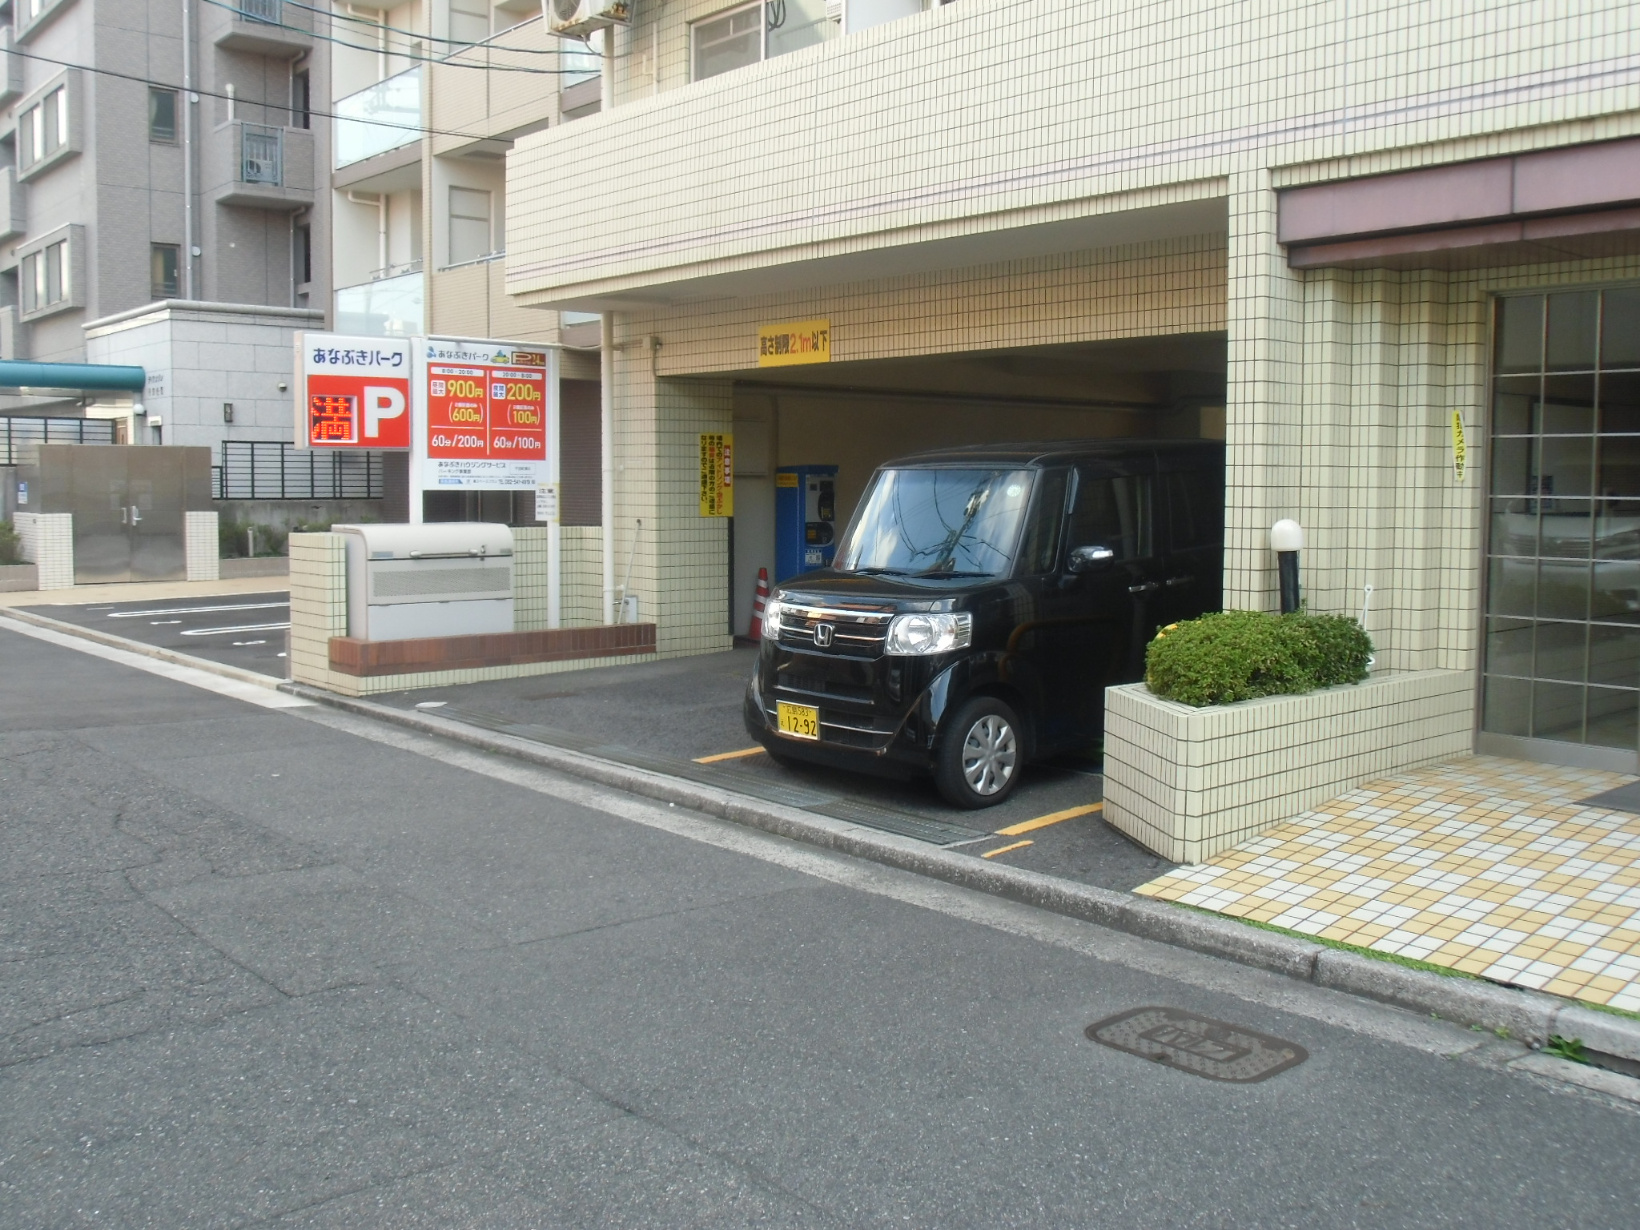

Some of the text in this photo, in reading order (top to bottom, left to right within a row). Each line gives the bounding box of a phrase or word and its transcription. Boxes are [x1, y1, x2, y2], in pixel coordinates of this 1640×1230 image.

[313, 348, 402, 367] あなぶきパーク
[438, 350, 489, 361] あなぶきパーク
[447, 380, 484, 398] 900円
[506, 383, 541, 401] 200円
[311, 397, 352, 440] 満
[364, 386, 405, 438] P
[787, 716, 817, 737] 12-92
